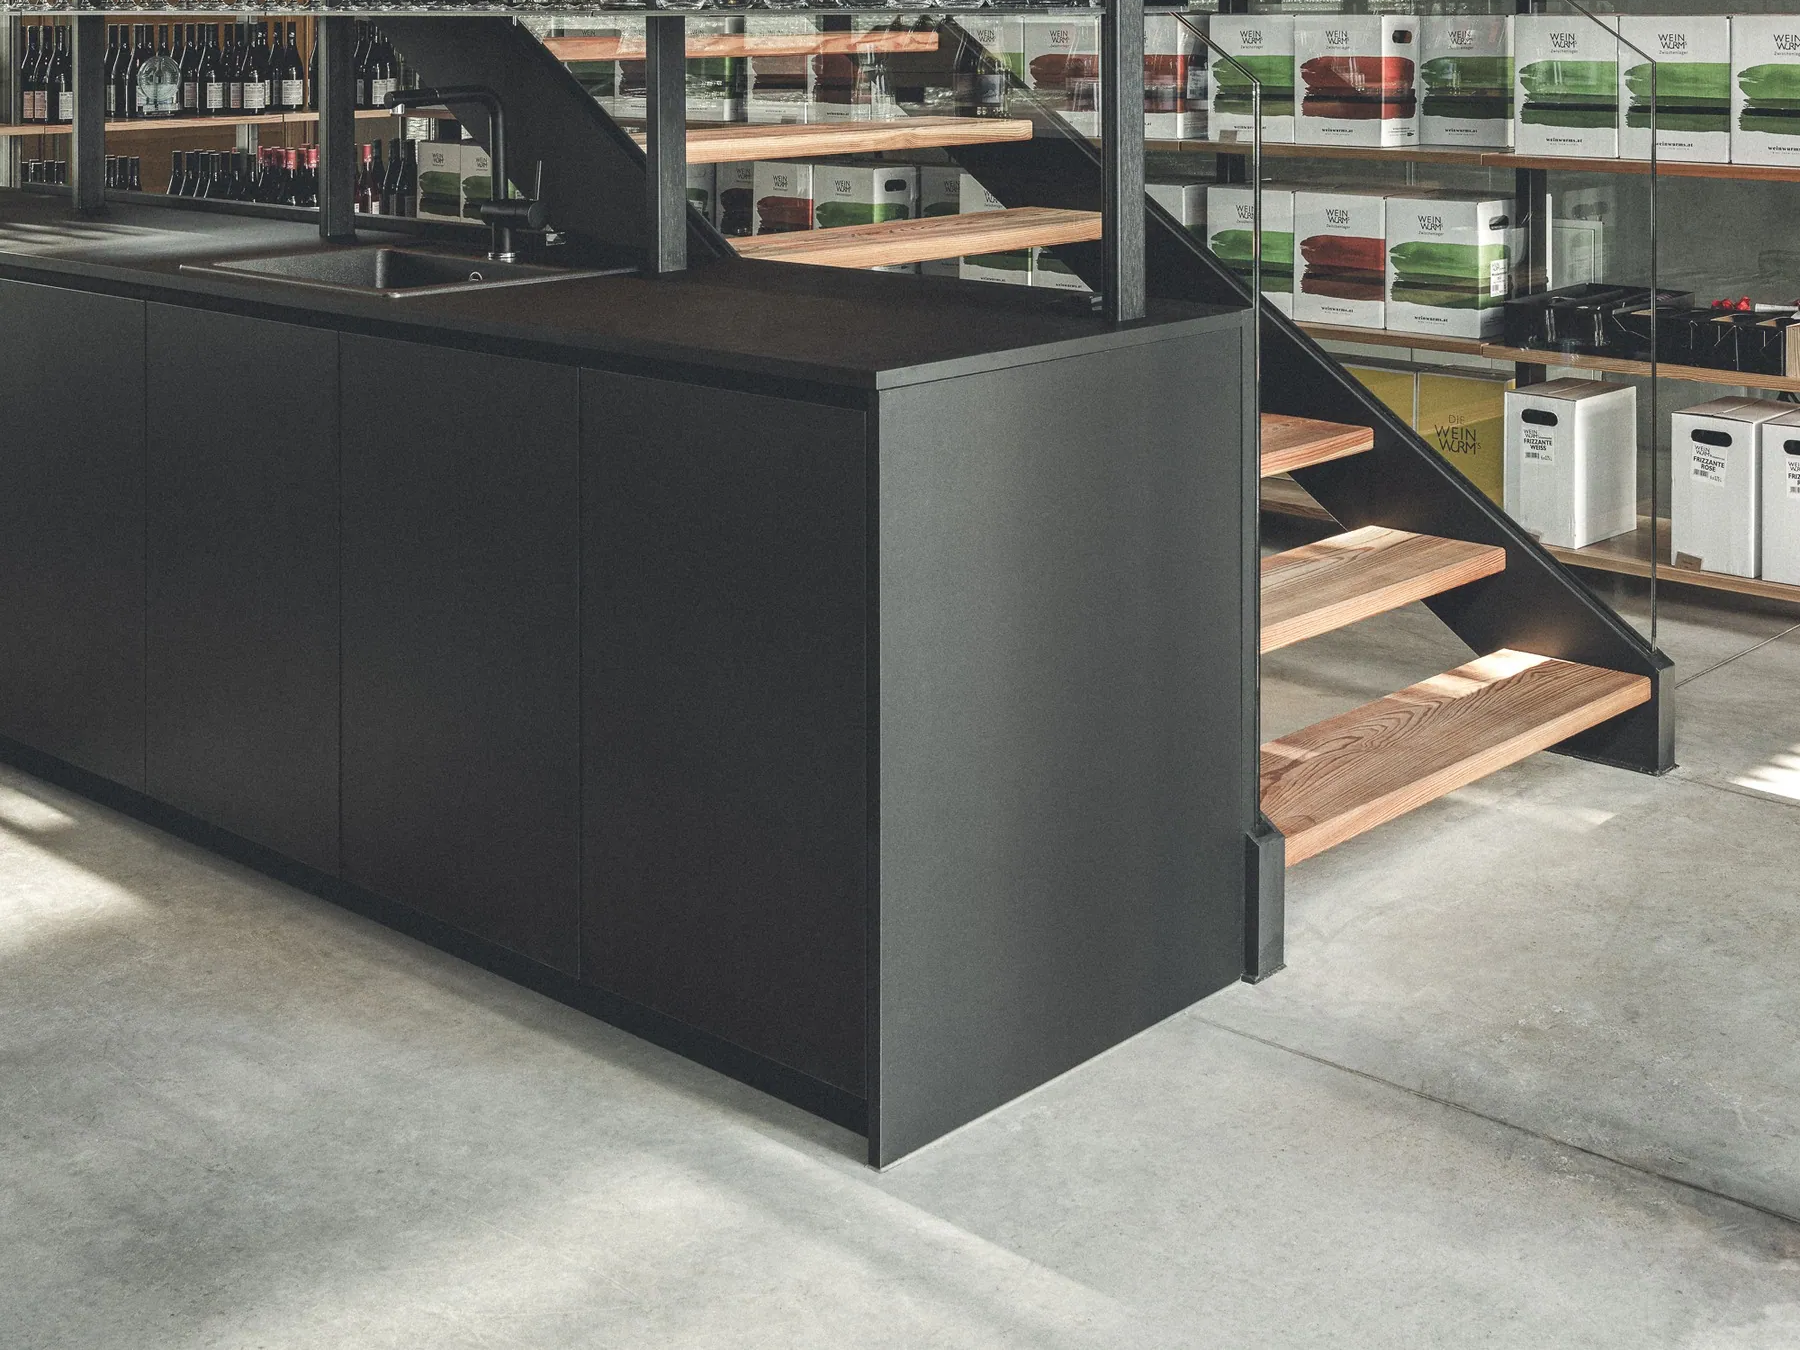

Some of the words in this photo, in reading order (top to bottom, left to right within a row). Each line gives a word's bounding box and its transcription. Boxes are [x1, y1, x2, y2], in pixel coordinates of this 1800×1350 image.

[1240, 30, 1261, 38] WEIN
[1325, 30, 1347, 38] WEIN
[1448, 30, 1471, 39] WEIN
[1549, 33, 1575, 41] WEIN
[1658, 33, 1685, 42] WEIN
[1326, 209, 1349, 217] WEIN
[1417, 215, 1442, 223] WEIN
[1448, 415, 1465, 424] DIE
[1434, 424, 1477, 442] WEIN
[1523, 438, 1552, 446] FRIZZANTE
[1693, 456, 1725, 469] FRIZZANTE
